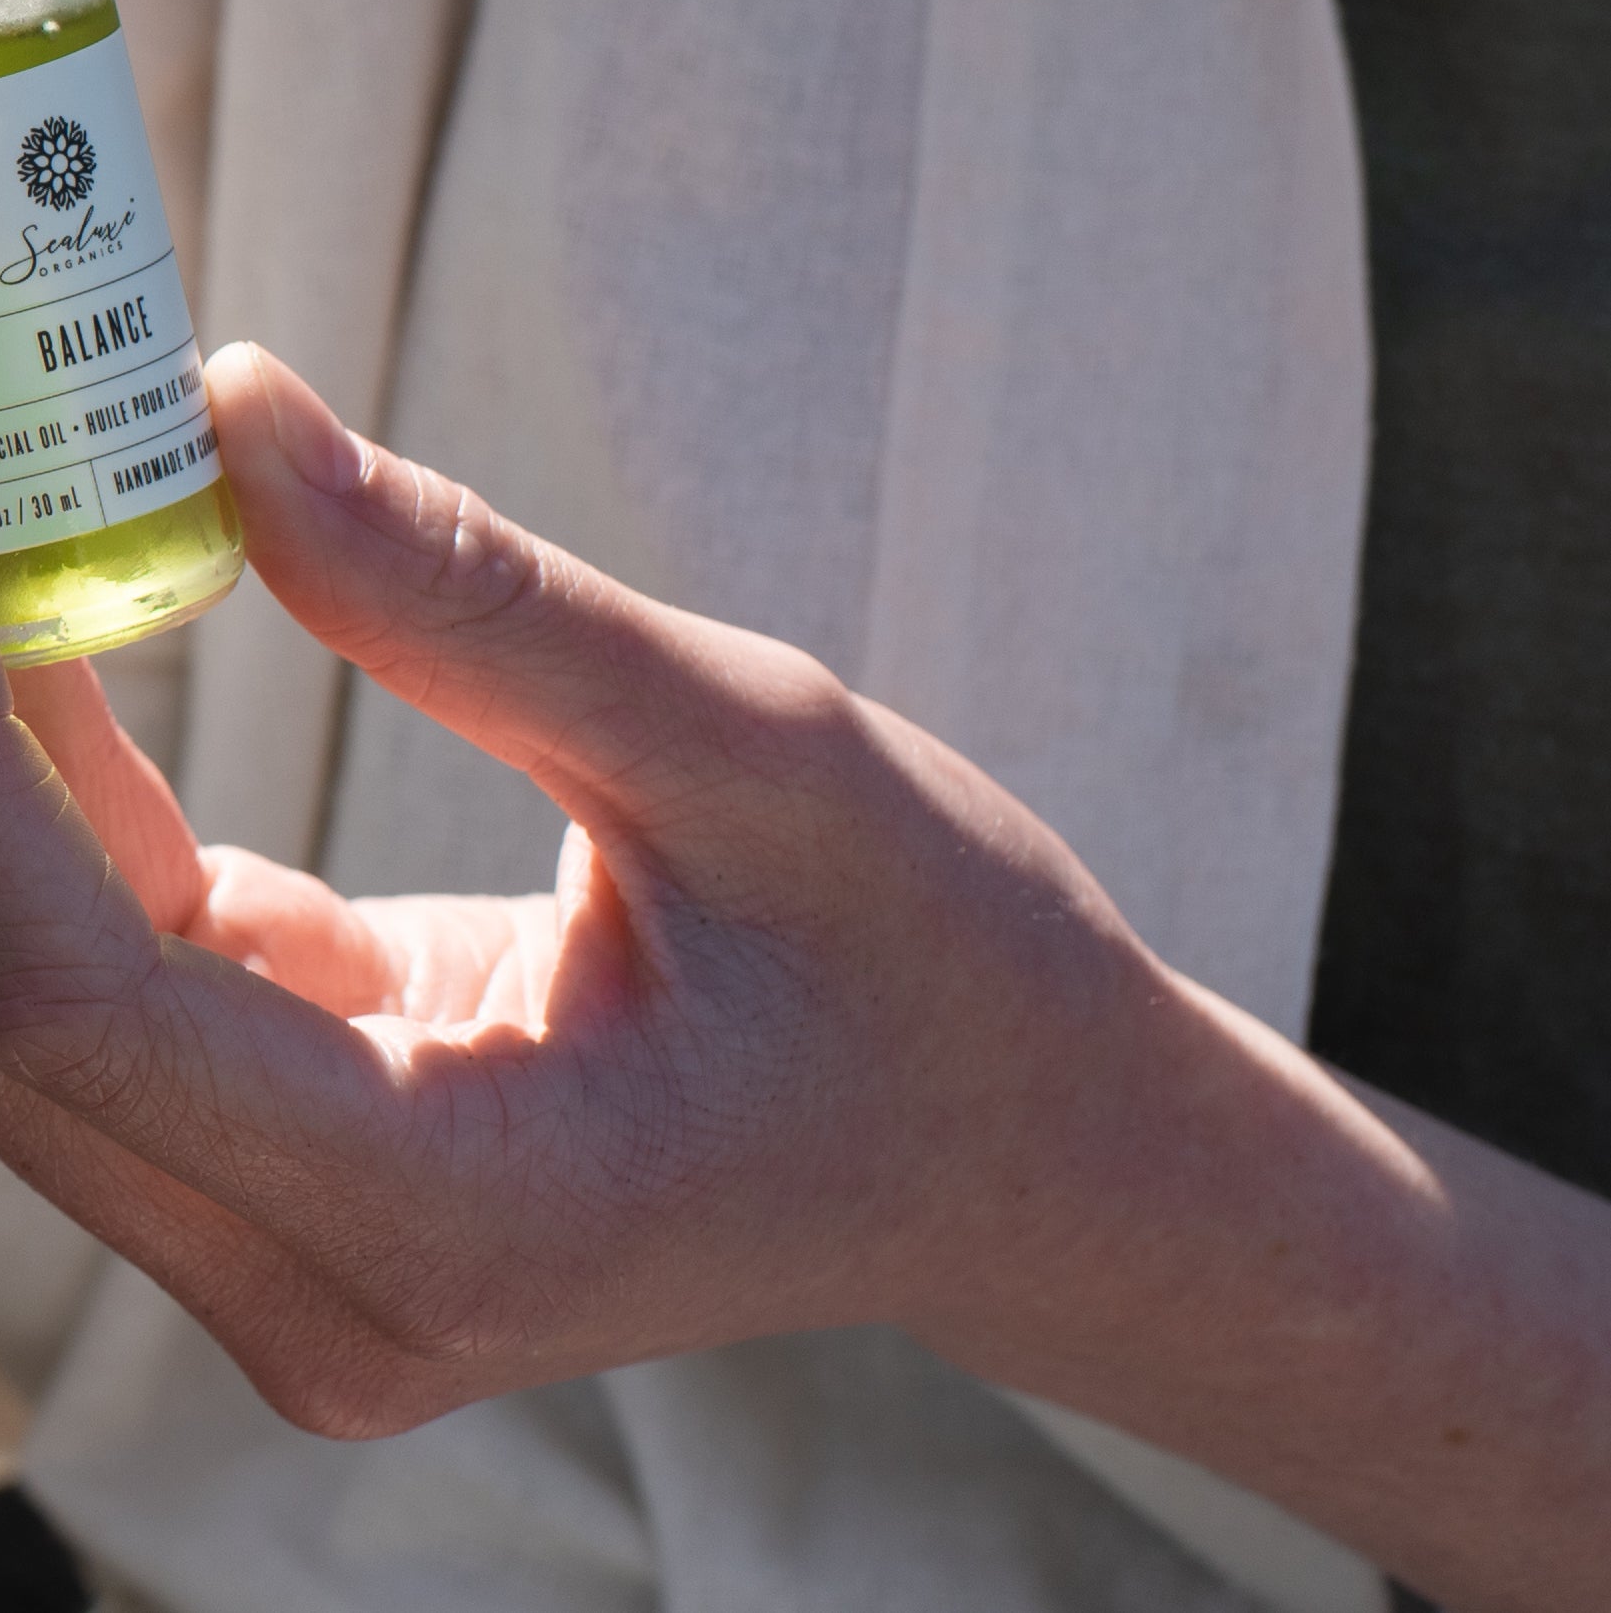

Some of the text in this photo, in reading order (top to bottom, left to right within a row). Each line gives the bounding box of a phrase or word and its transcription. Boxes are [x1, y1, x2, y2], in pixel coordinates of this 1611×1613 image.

[39, 240, 123, 277] ORGANICS
[37, 295, 153, 373] BALANCE
[39, 422, 67, 449] OIL
[85, 401, 129, 436] HUILE
[132, 387, 166, 420] POUR
[166, 379, 180, 405] LE
[113, 448, 184, 495] HANDMADE
[183, 440, 197, 466] IN
[31, 493, 53, 519] 30
[60, 486, 82, 512] mL
